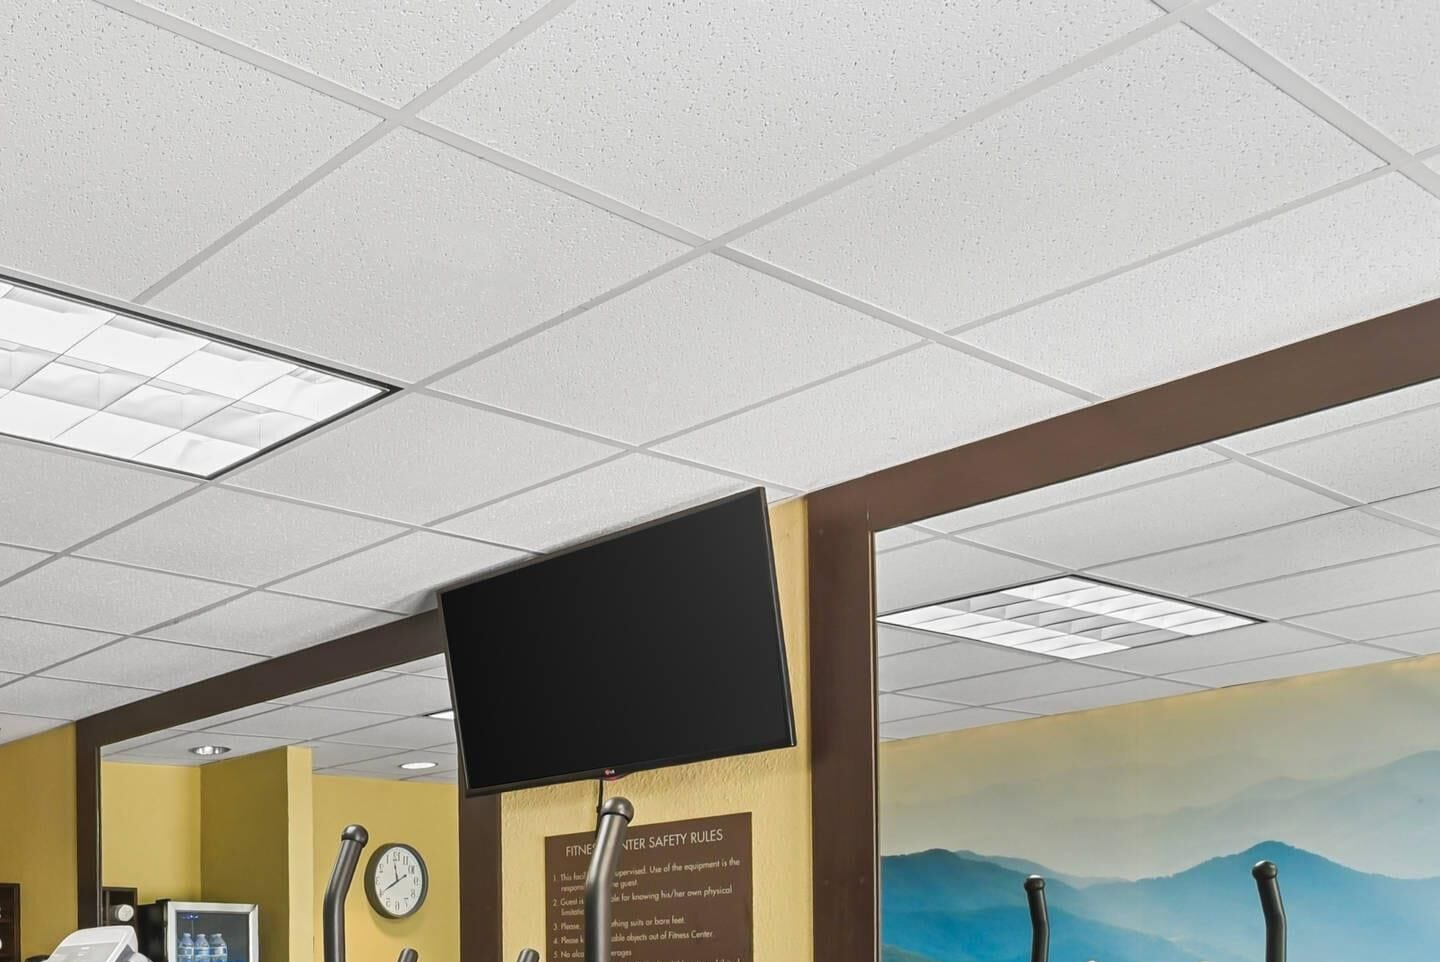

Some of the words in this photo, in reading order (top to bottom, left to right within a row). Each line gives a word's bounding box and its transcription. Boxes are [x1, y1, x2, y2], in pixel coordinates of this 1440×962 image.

[565, 843, 596, 857] FITNE
[622, 838, 645, 851] NTER
[649, 832, 687, 848] SAFETY
[691, 829, 723, 843] RULES
[560, 874, 573, 882] This
[650, 866, 662, 874] Use
[663, 863, 671, 873] of
[672, 863, 682, 872] the
[684, 860, 720, 874] equipment
[729, 857, 740, 866] the
[632, 892, 659, 902] knowing
[661, 889, 685, 899] his/her
[703, 884, 733, 898] physical
[654, 917, 670, 925] bare
[627, 932, 647, 943] objects
[660, 931, 668, 940] of
[668, 931, 689, 939] Fitness
